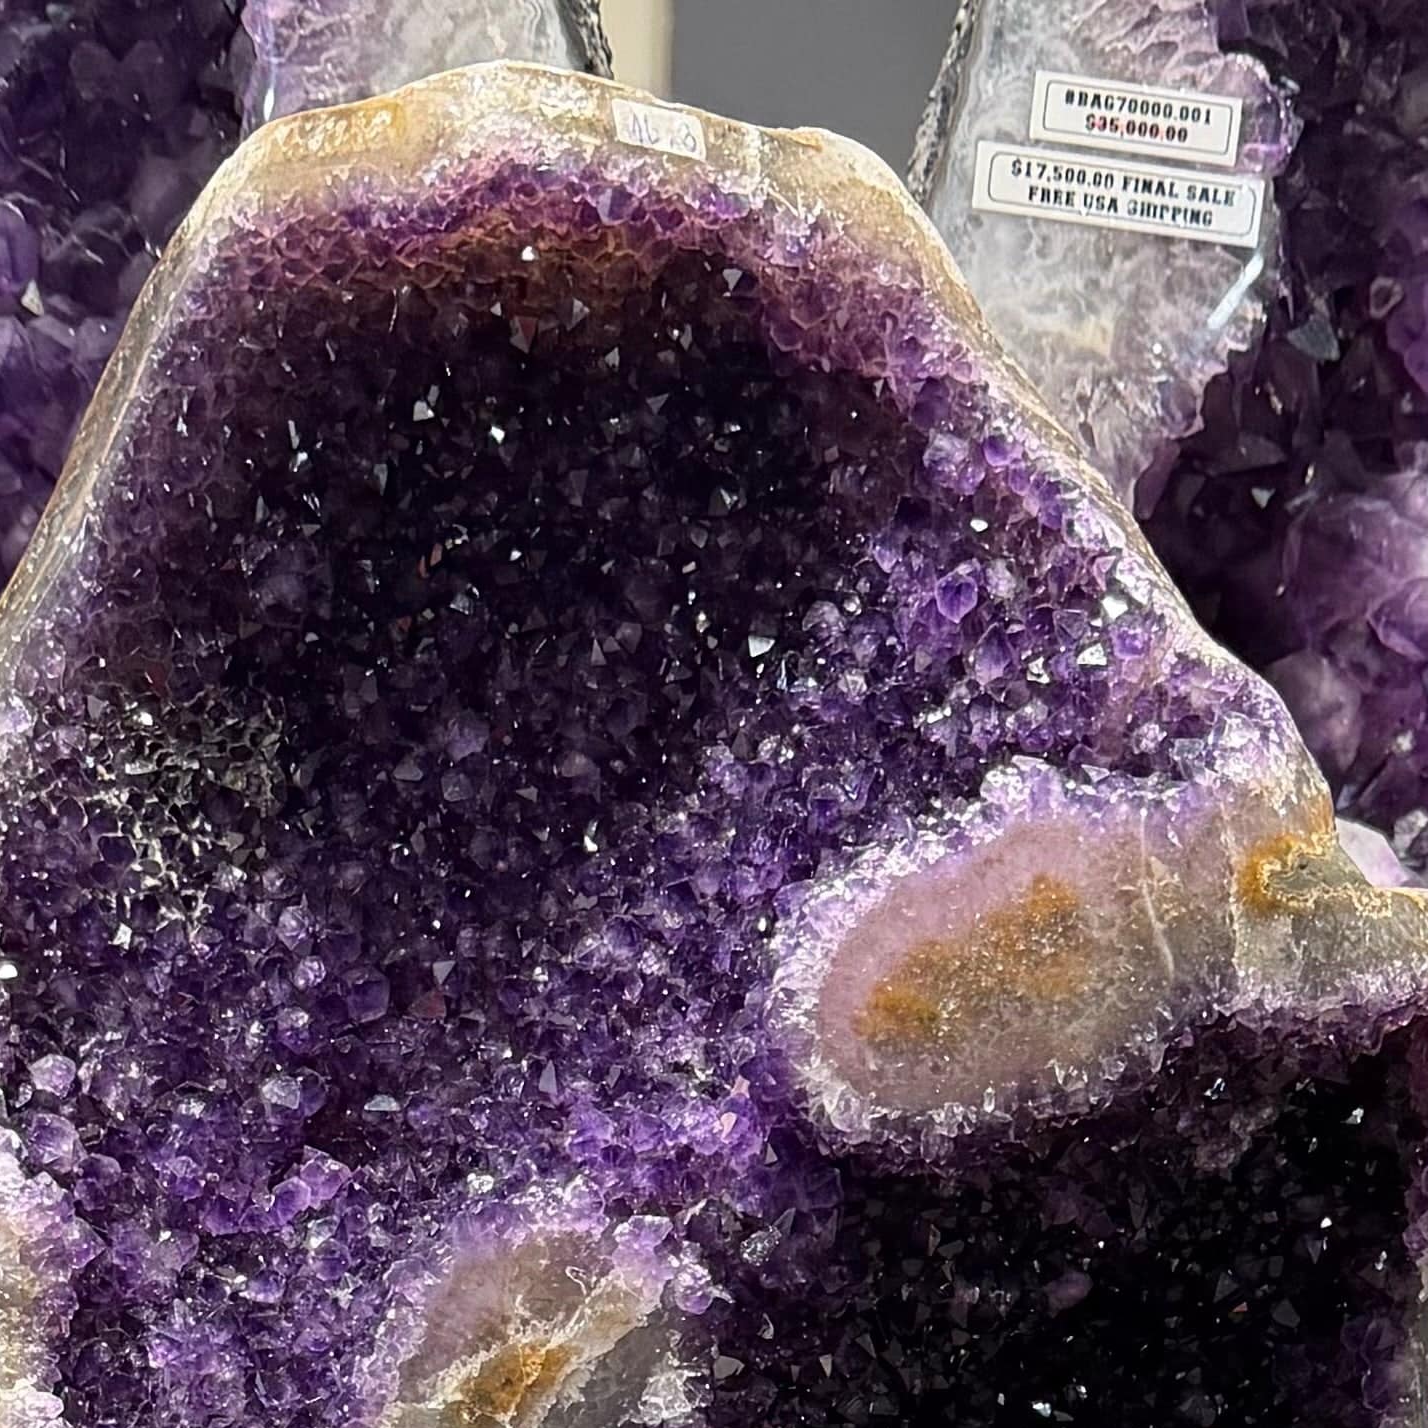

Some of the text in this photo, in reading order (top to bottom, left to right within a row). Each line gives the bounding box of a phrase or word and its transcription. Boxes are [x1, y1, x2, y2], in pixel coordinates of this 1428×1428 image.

[1011, 158, 1236, 207] $17,500.00 FINAL SALE
[1027, 185, 1214, 227] FREE USA SHIPPING
